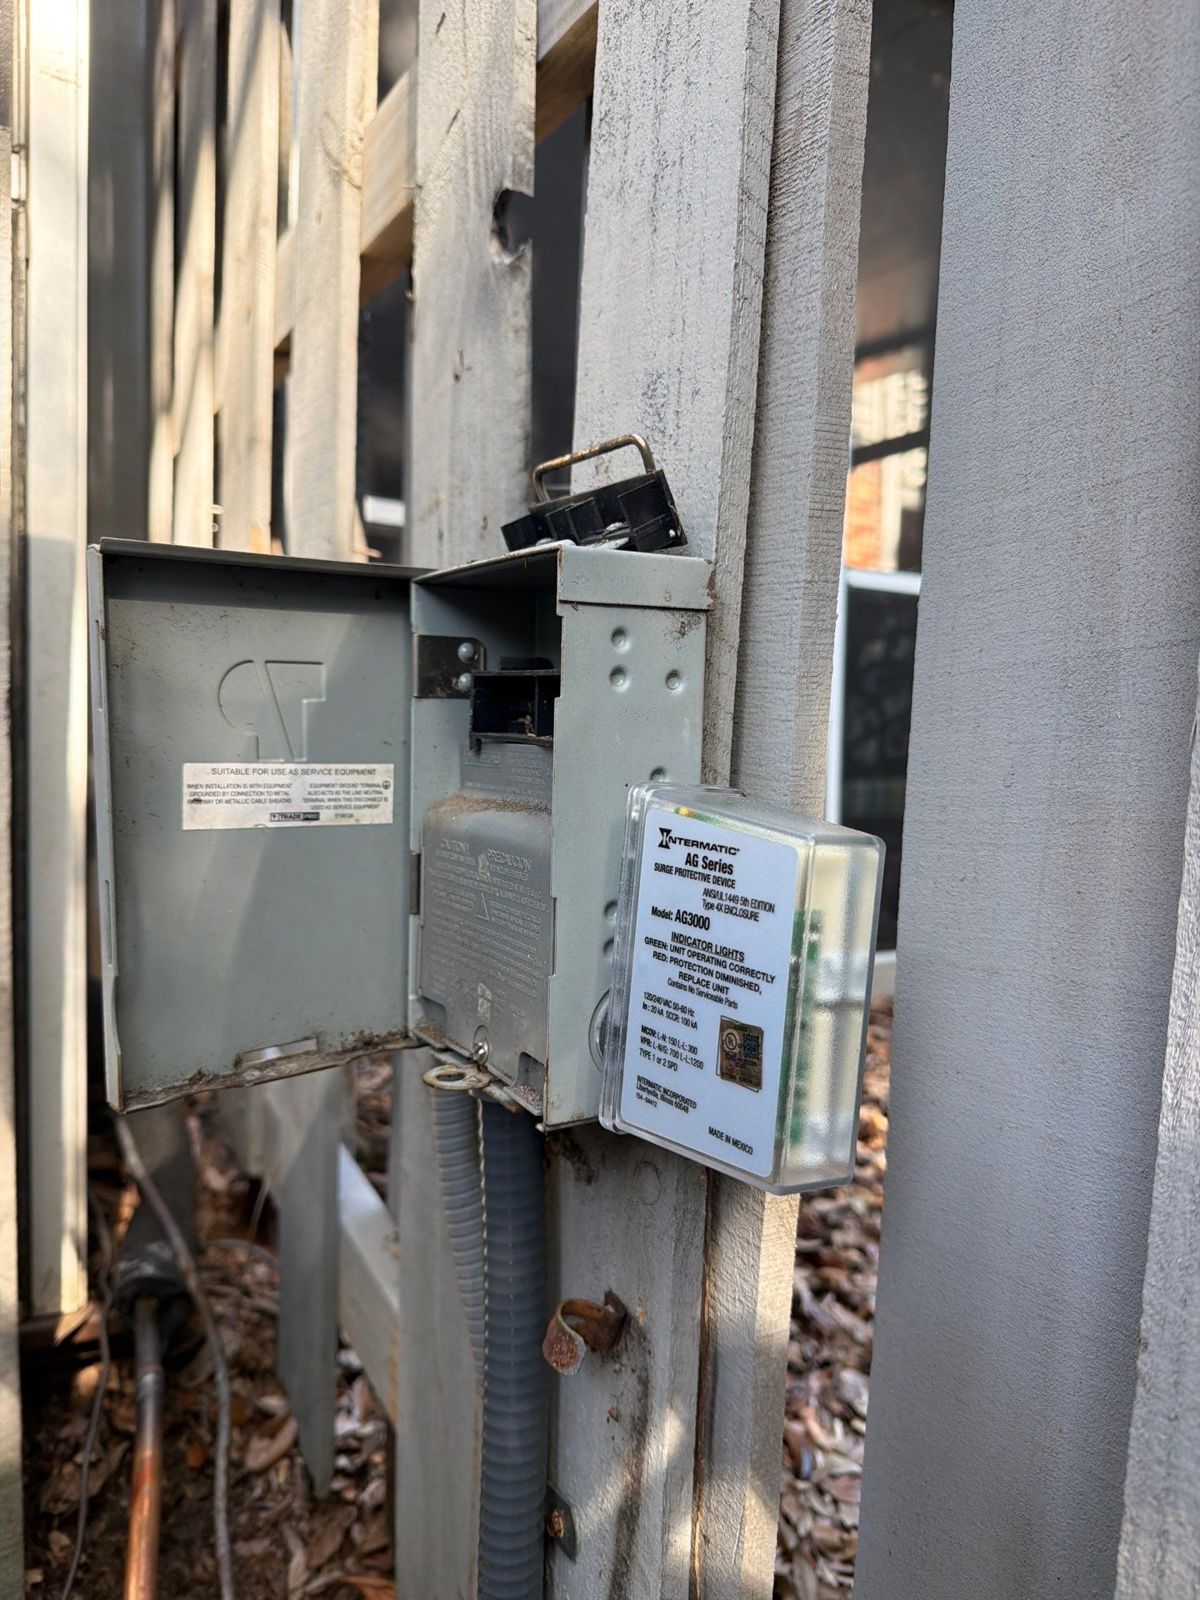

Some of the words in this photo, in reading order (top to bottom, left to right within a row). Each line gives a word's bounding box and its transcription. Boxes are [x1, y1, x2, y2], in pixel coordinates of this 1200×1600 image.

[211, 768, 250, 776] SUITABLE
[252, 768, 269, 776] FOR
[271, 768, 287, 776] USE
[288, 768, 299, 776] AS
[300, 767, 333, 776] SERVICE
[334, 767, 377, 776] EQUIPMENT
[658, 827, 738, 856] INTERMATIC
[653, 862, 674, 875] SURGE
[674, 867, 712, 884] PROTECTIVE
[712, 875, 736, 889] DEVICE
[685, 852, 699, 868] AG
[701, 855, 734, 875] Series
[702, 899, 715, 911] Type
[715, 902, 724, 913] 4X
[724, 904, 760, 922] ENCLOSURE
[739, 896, 750, 907] 5th
[750, 898, 776, 913] EDITION
[651, 906, 673, 921] Model:
[674, 909, 710, 931] AG3000
[671, 931, 713, 952] INDICATOR
[715, 944, 745, 963] LIGHTS
[644, 936, 669, 951] GREEN:
[670, 944, 686, 956] UNIT
[687, 949, 727, 969] OPERATING
[729, 962, 775, 984] CORRECTLY
[653, 951, 668, 963] RED:
[669, 955, 714, 977] PROTECTION
[715, 971, 761, 995] DIMINISHED,
[678, 971, 711, 989] REPLACE
[712, 982, 730, 995] UNIT
[667, 977, 688, 991] Contains
[688, 985, 695, 994] No
[695, 987, 724, 1004] Serviceable
[724, 997, 738, 1009] Parts
[651, 1004, 658, 1014] 20
[681, 1016, 691, 1027] 100
[690, 1020, 698, 1030] kA
[672, 1001, 687, 1015] 50-60
[687, 1007, 695, 1017] Hz
[639, 1047, 652, 1061] TYPE
[656, 1056, 662, 1065] or
[662, 1058, 667, 1068] 2
[667, 1060, 678, 1072] SPD
[669, 1047, 680, 1059] 700
[688, 1044, 698, 1055] 300
[636, 1074, 662, 1093] INTERMATIC
[662, 1086, 697, 1110] INCORPORATED
[708, 1125, 725, 1141] MADE
[724, 1134, 731, 1145] IN
[731, 1137, 754, 1156] MEXICO
